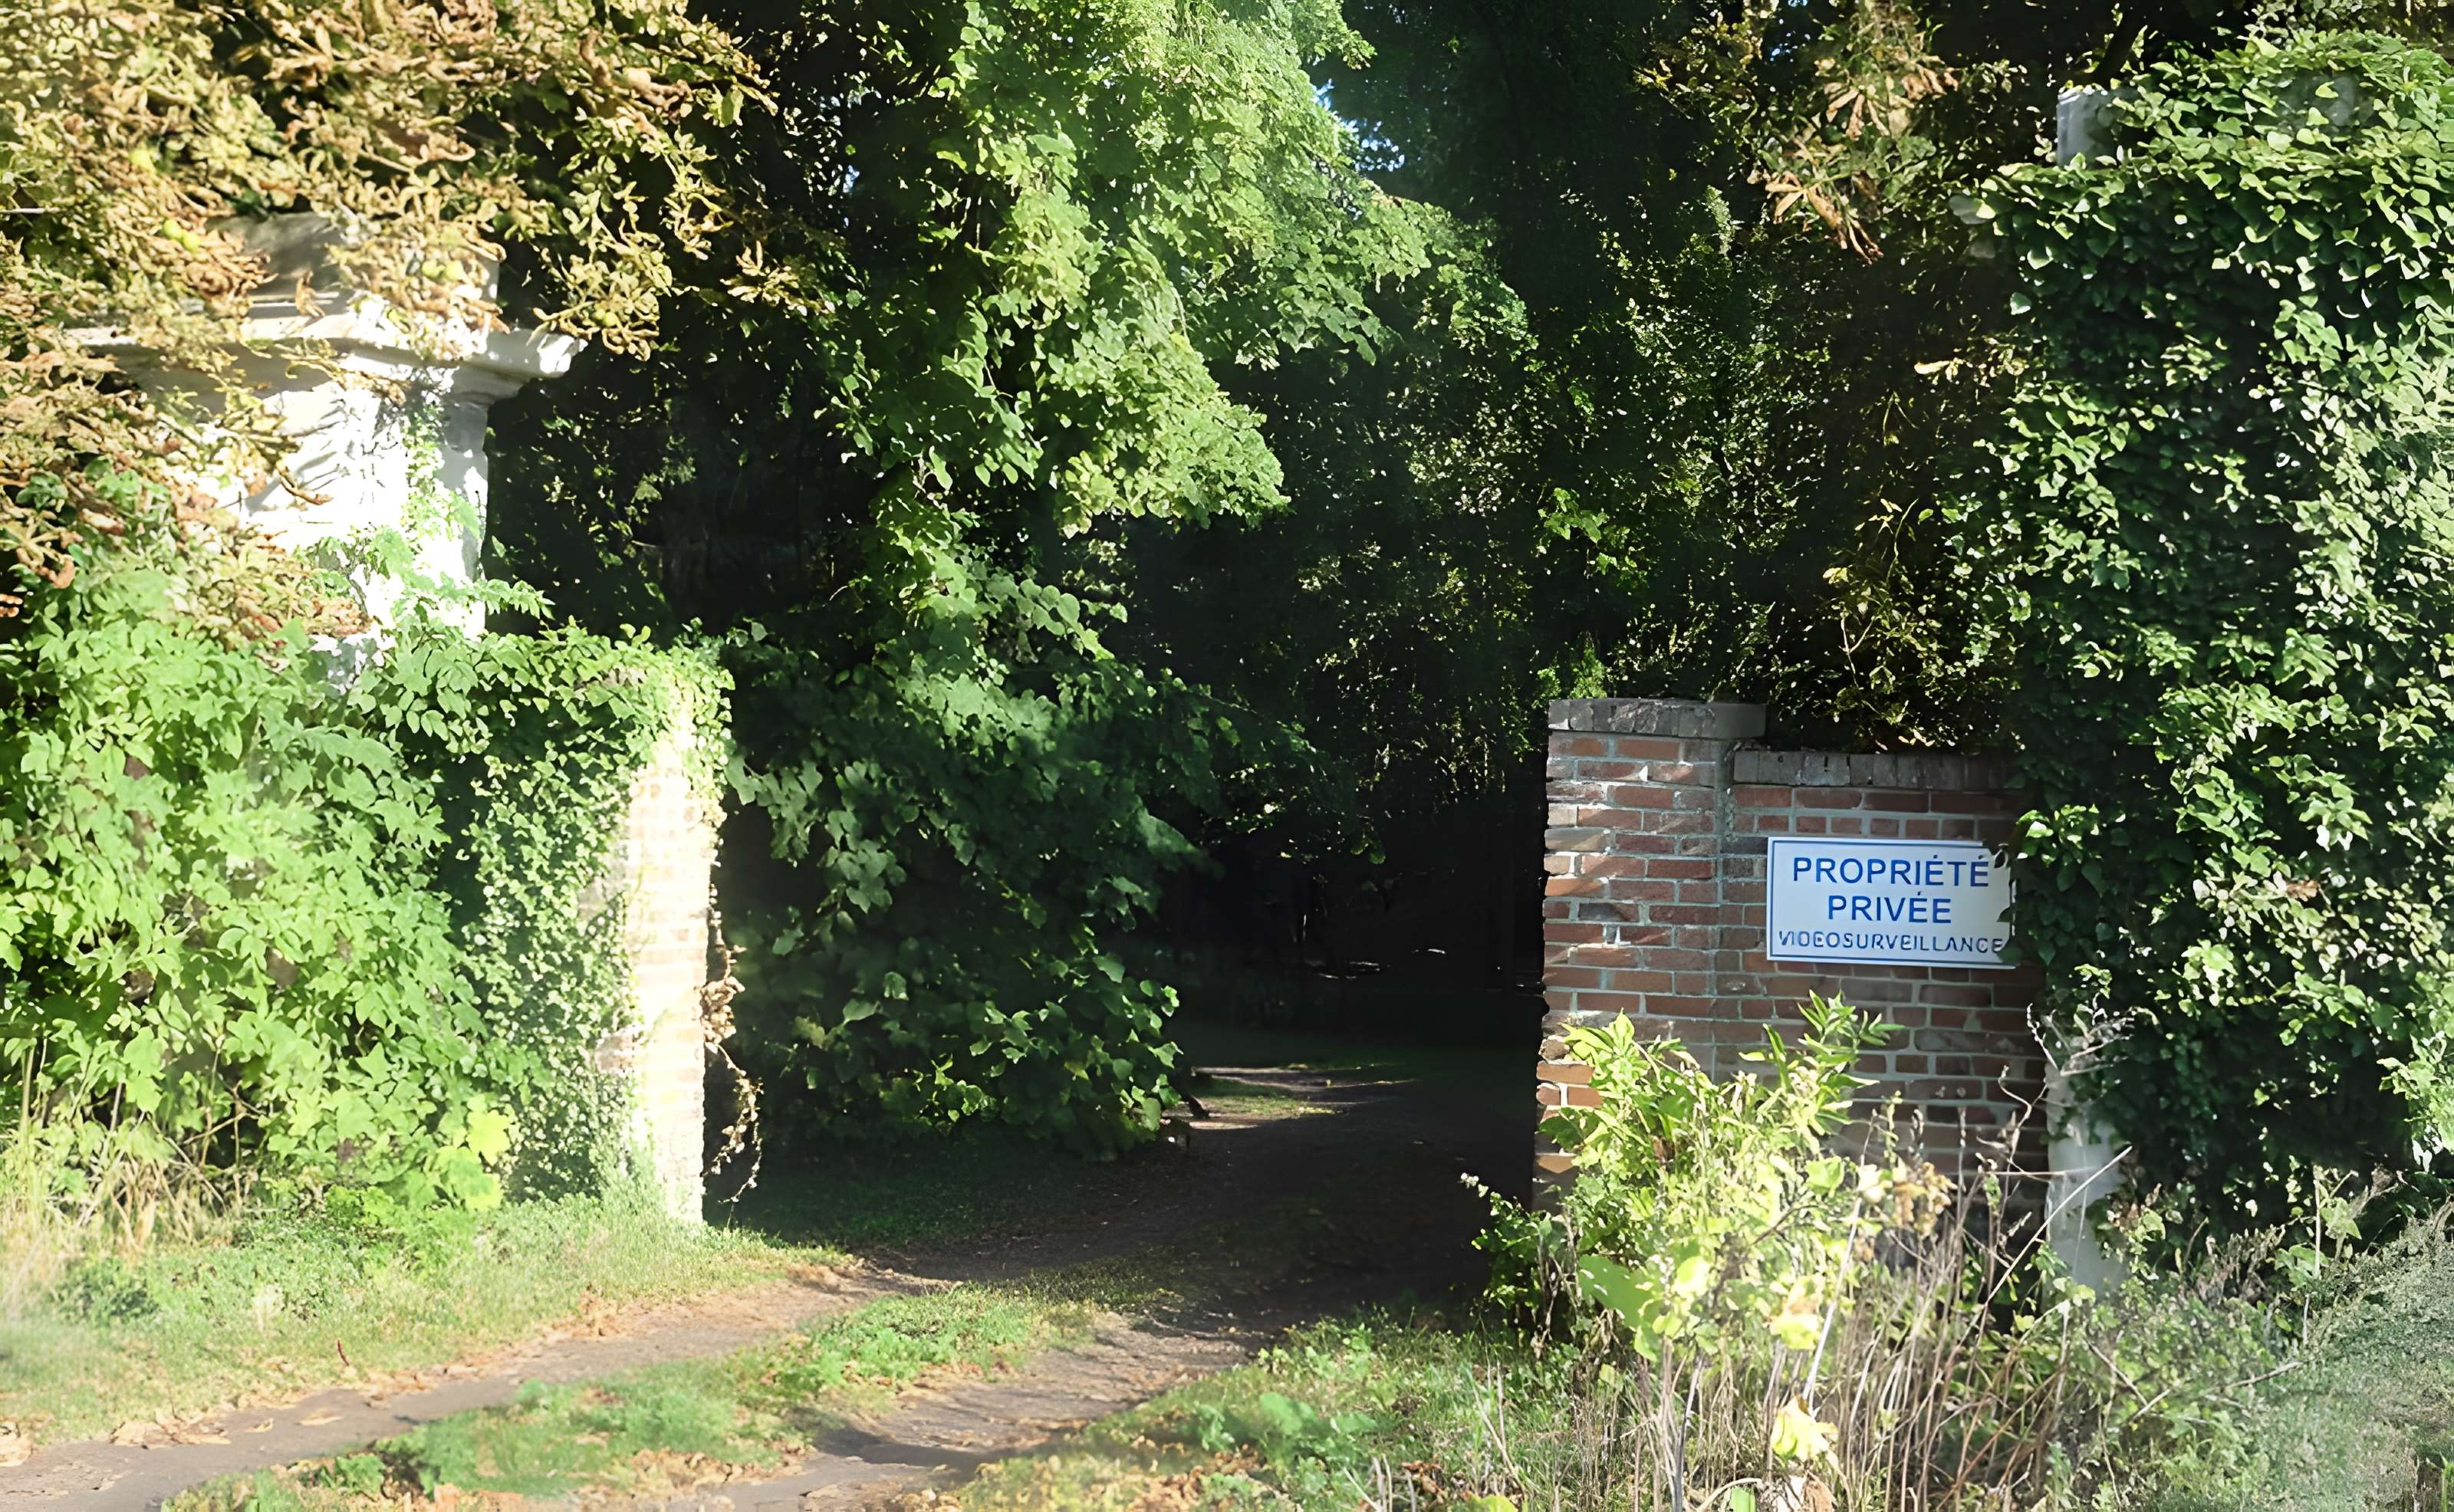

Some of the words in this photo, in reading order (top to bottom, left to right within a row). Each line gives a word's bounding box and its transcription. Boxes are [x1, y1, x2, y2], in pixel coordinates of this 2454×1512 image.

[1794, 854, 1989, 887] PROPRIÉTÉ
[1828, 892, 1952, 923] PRIVÉE
[1779, 930, 2003, 953] VIDEOSURVEILLANCE
